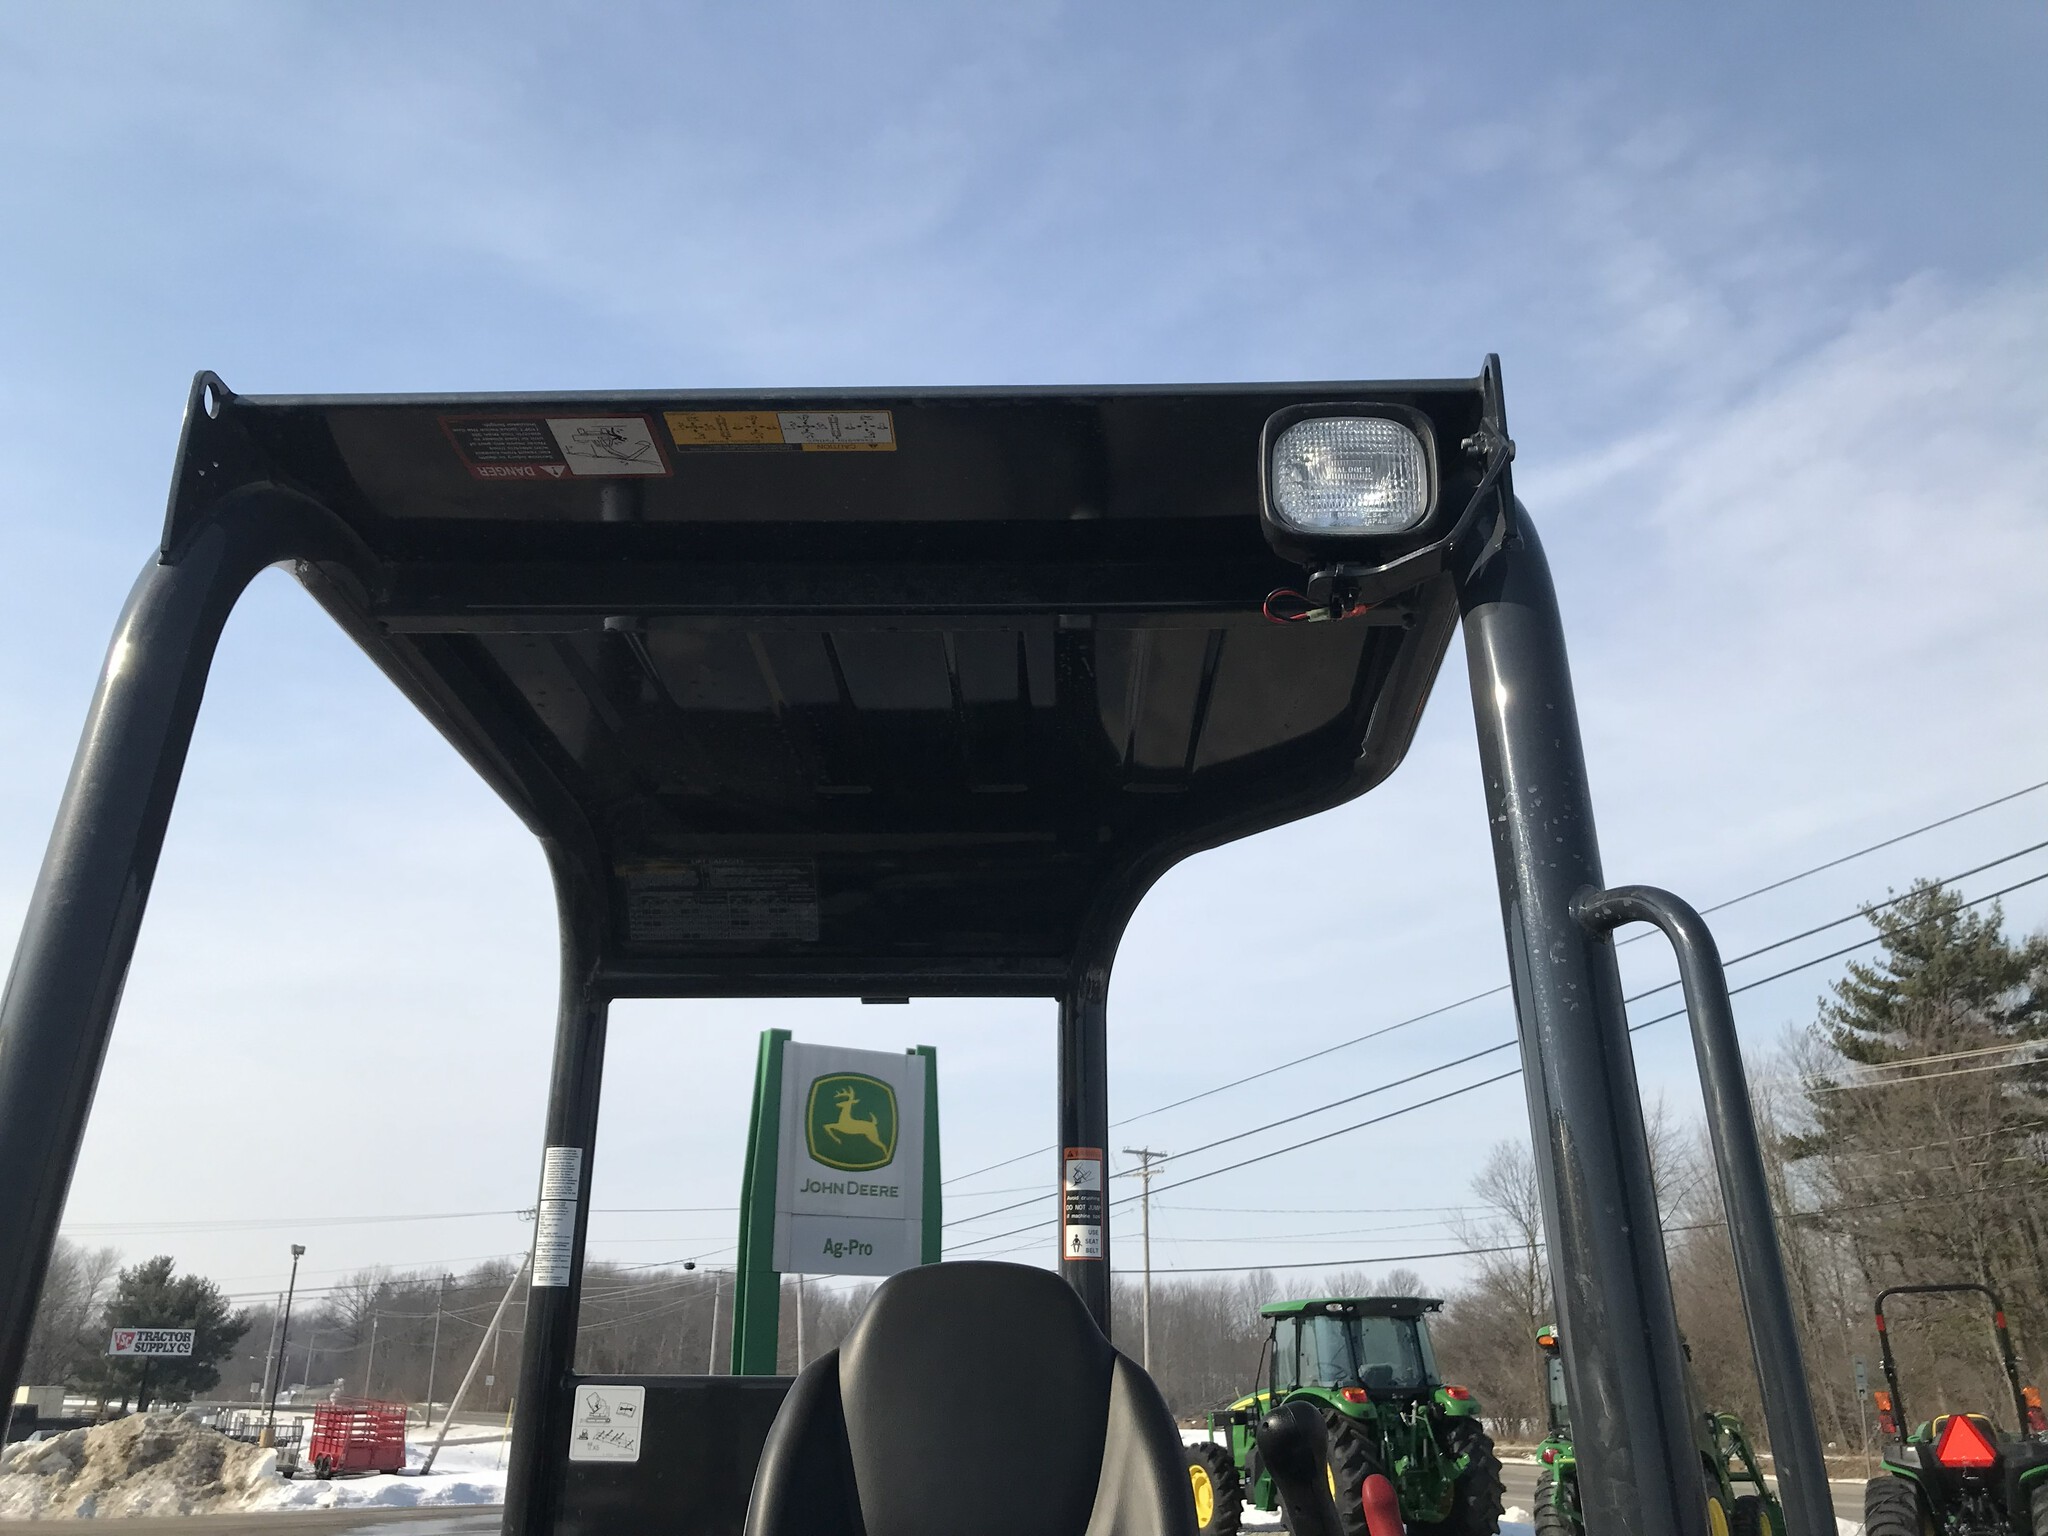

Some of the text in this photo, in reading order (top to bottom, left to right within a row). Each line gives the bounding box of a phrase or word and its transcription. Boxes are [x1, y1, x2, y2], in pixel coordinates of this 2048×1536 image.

[477, 466, 537, 477] DANGER
[800, 1178, 899, 1198] JOHN DEERE
[823, 1238, 873, 1258] Ag-Pro
[137, 1331, 192, 1342] TRACTOR
[134, 1342, 177, 1353] SUPPLY
